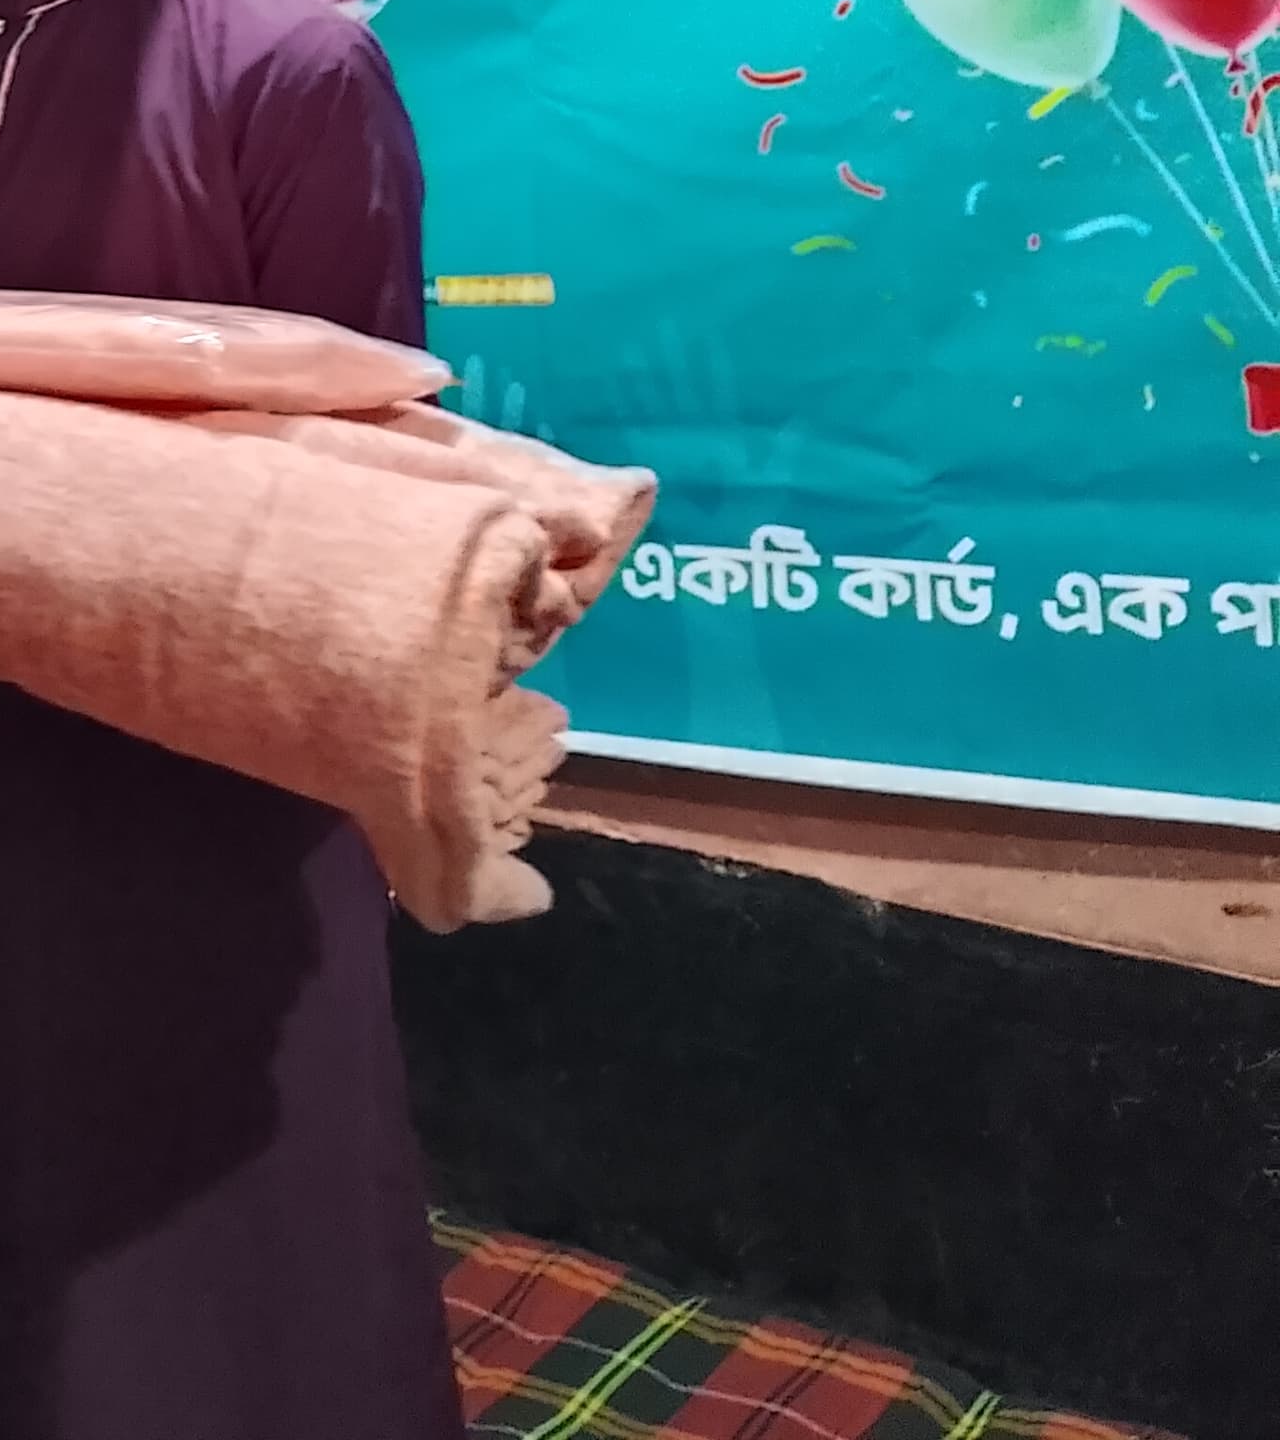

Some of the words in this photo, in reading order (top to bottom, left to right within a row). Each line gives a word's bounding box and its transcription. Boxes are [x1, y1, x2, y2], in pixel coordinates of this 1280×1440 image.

[621, 524, 822, 612] একটি
[832, 536, 1019, 641] কার্ড,
[1041, 571, 1191, 641] এক
